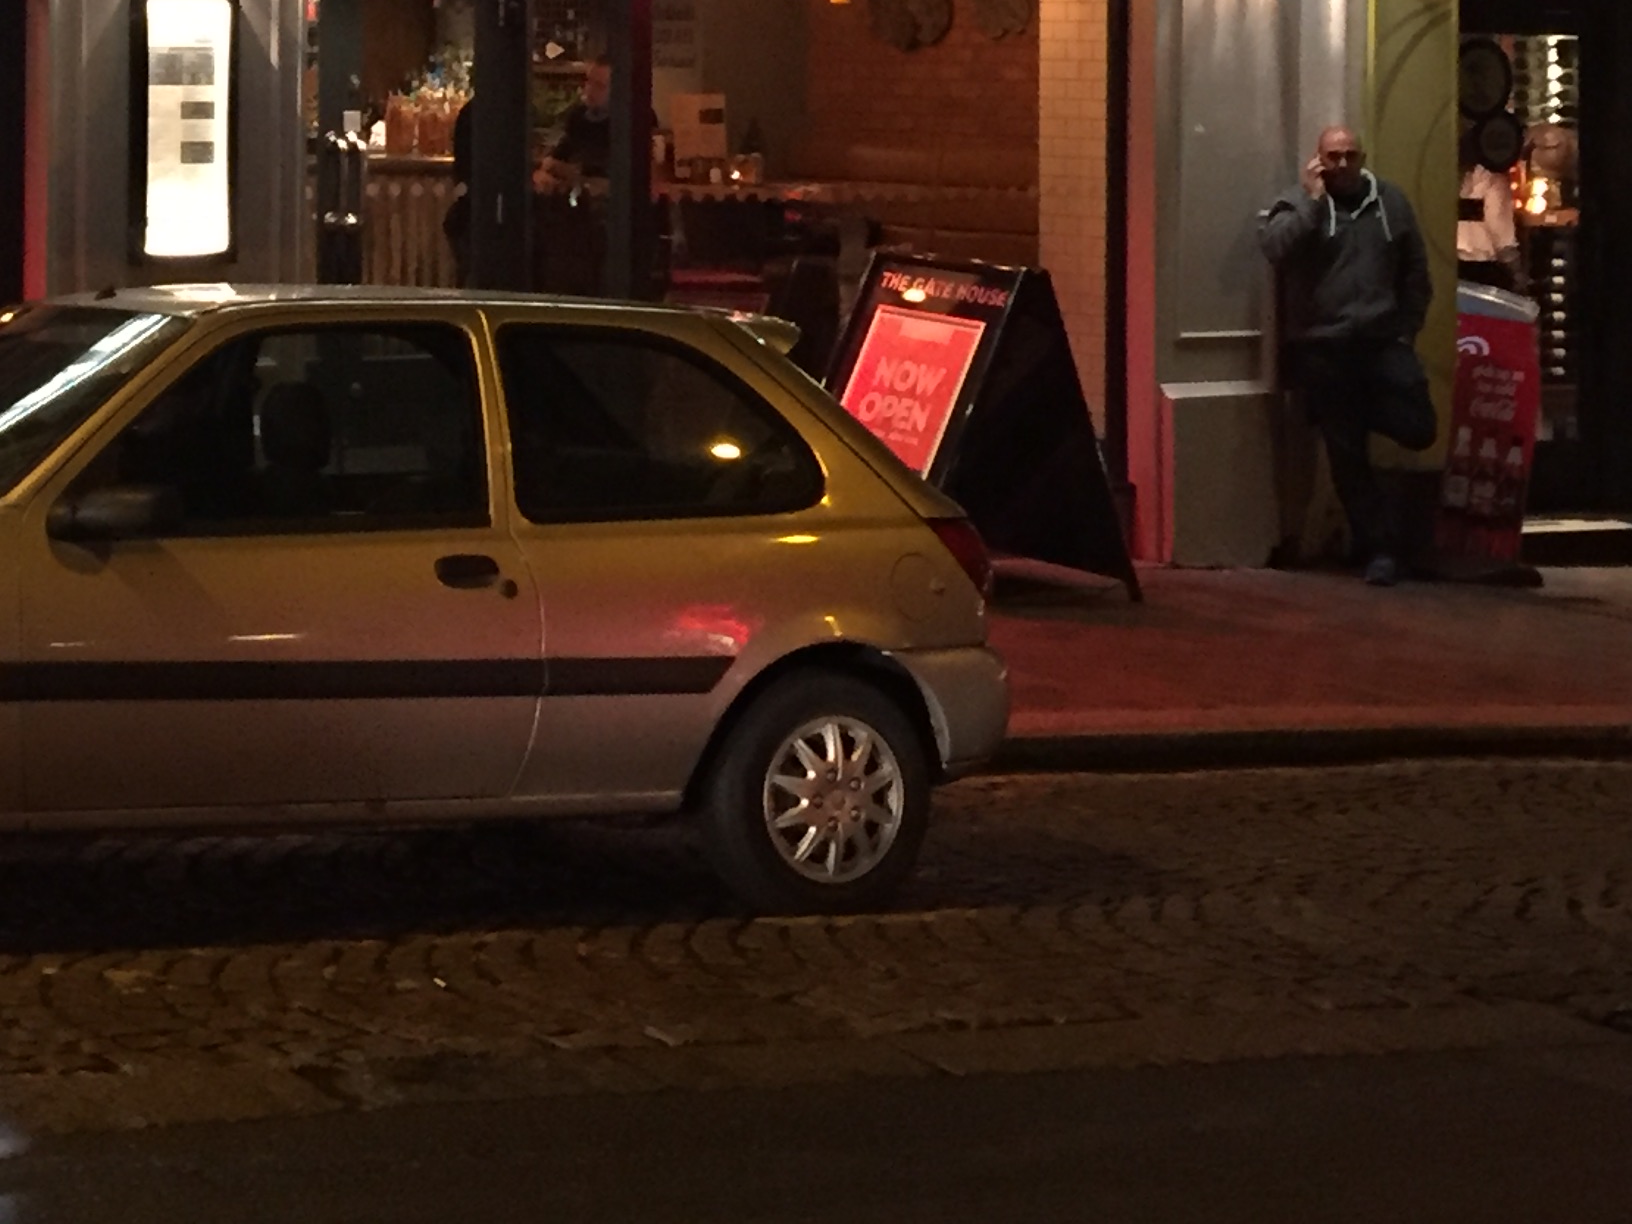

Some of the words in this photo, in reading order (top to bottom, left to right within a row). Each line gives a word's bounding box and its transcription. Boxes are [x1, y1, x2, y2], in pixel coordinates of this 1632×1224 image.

[880, 270, 910, 293] THE
[913, 276, 956, 300] GATE
[958, 284, 1009, 308] HOUSE
[872, 355, 948, 397] NOW
[858, 392, 933, 433] OPEN
